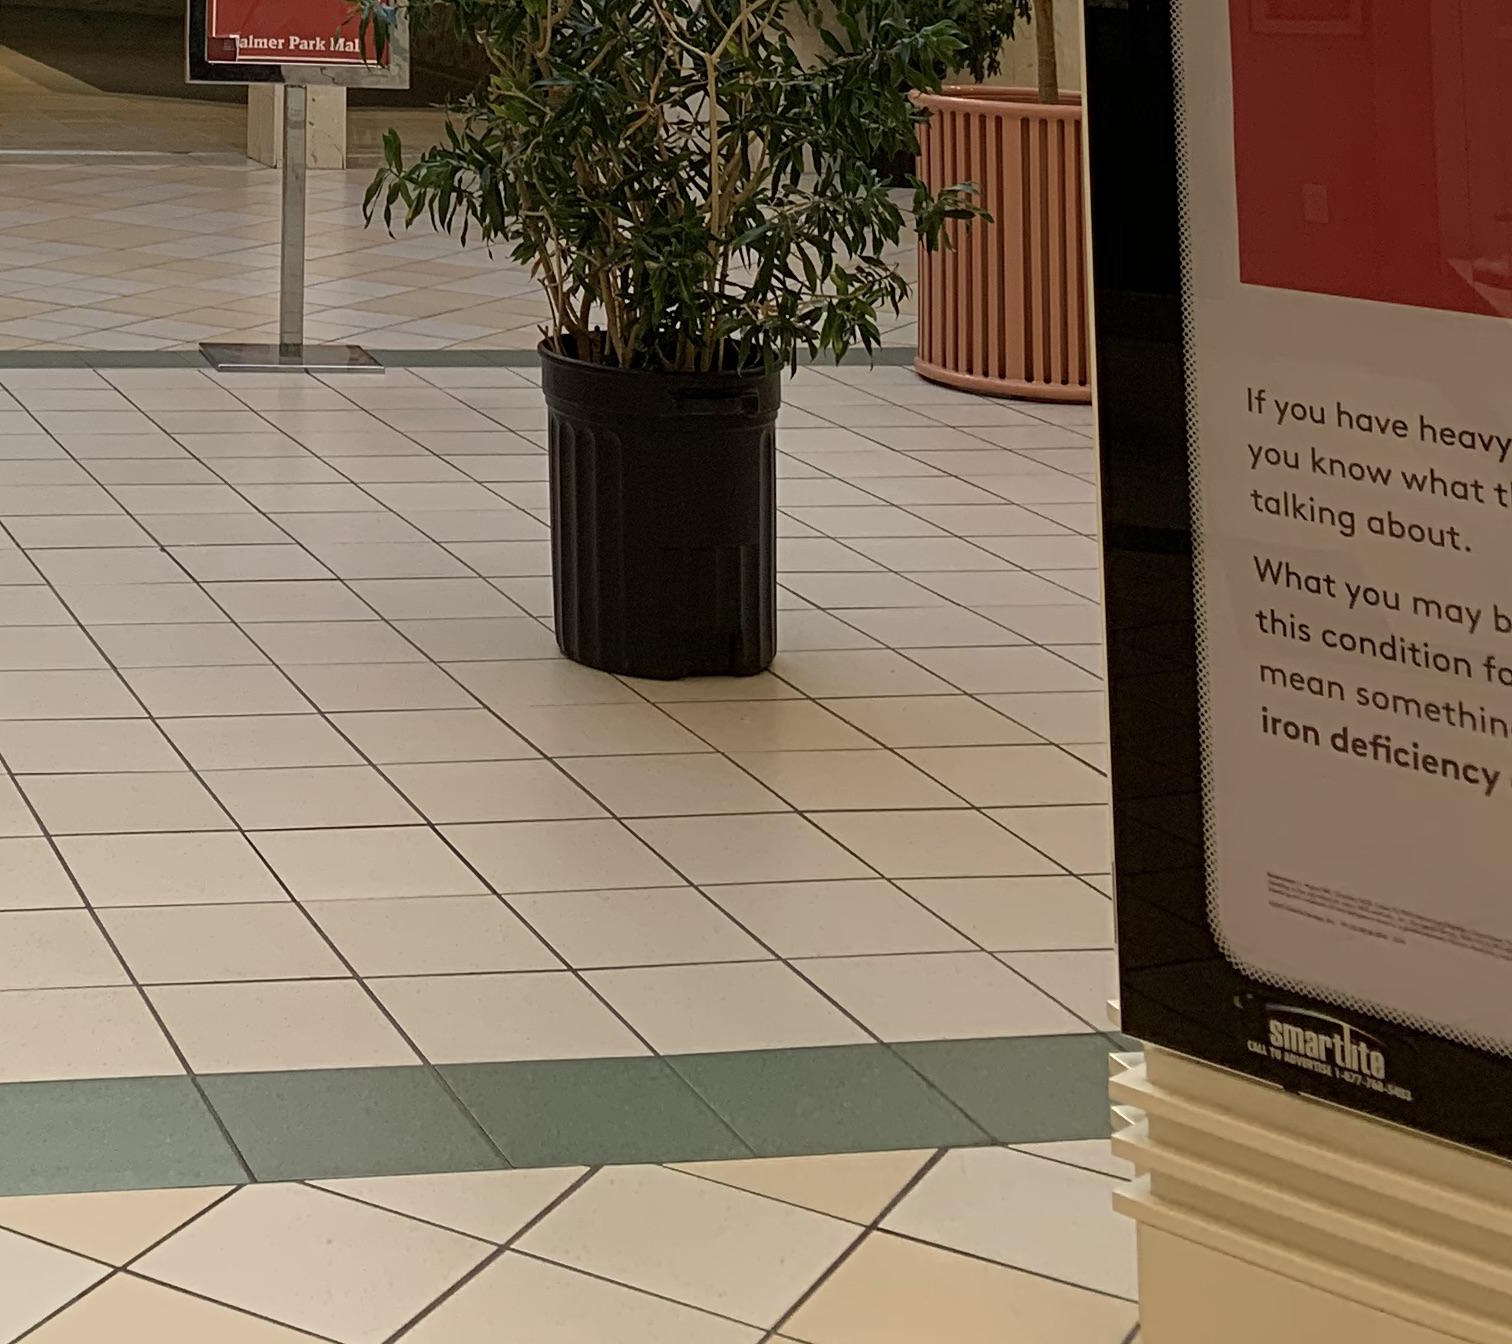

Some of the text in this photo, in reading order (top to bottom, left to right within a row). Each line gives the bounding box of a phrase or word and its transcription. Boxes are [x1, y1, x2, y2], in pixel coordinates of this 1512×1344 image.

[237, 35, 361, 53] almer Park Mal
[1246, 387, 1512, 463] If you have heavy
[1247, 442, 1512, 509] you know what t
[1250, 488, 1472, 553] talking about.
[1253, 555, 1336, 598] What
[1345, 580, 1400, 610] you
[1412, 596, 1482, 634] may
[1255, 609, 1311, 642] this
[1321, 626, 1472, 678] condition
[1259, 663, 1512, 739] mean somethin
[1261, 707, 1501, 797] iron deficiency
